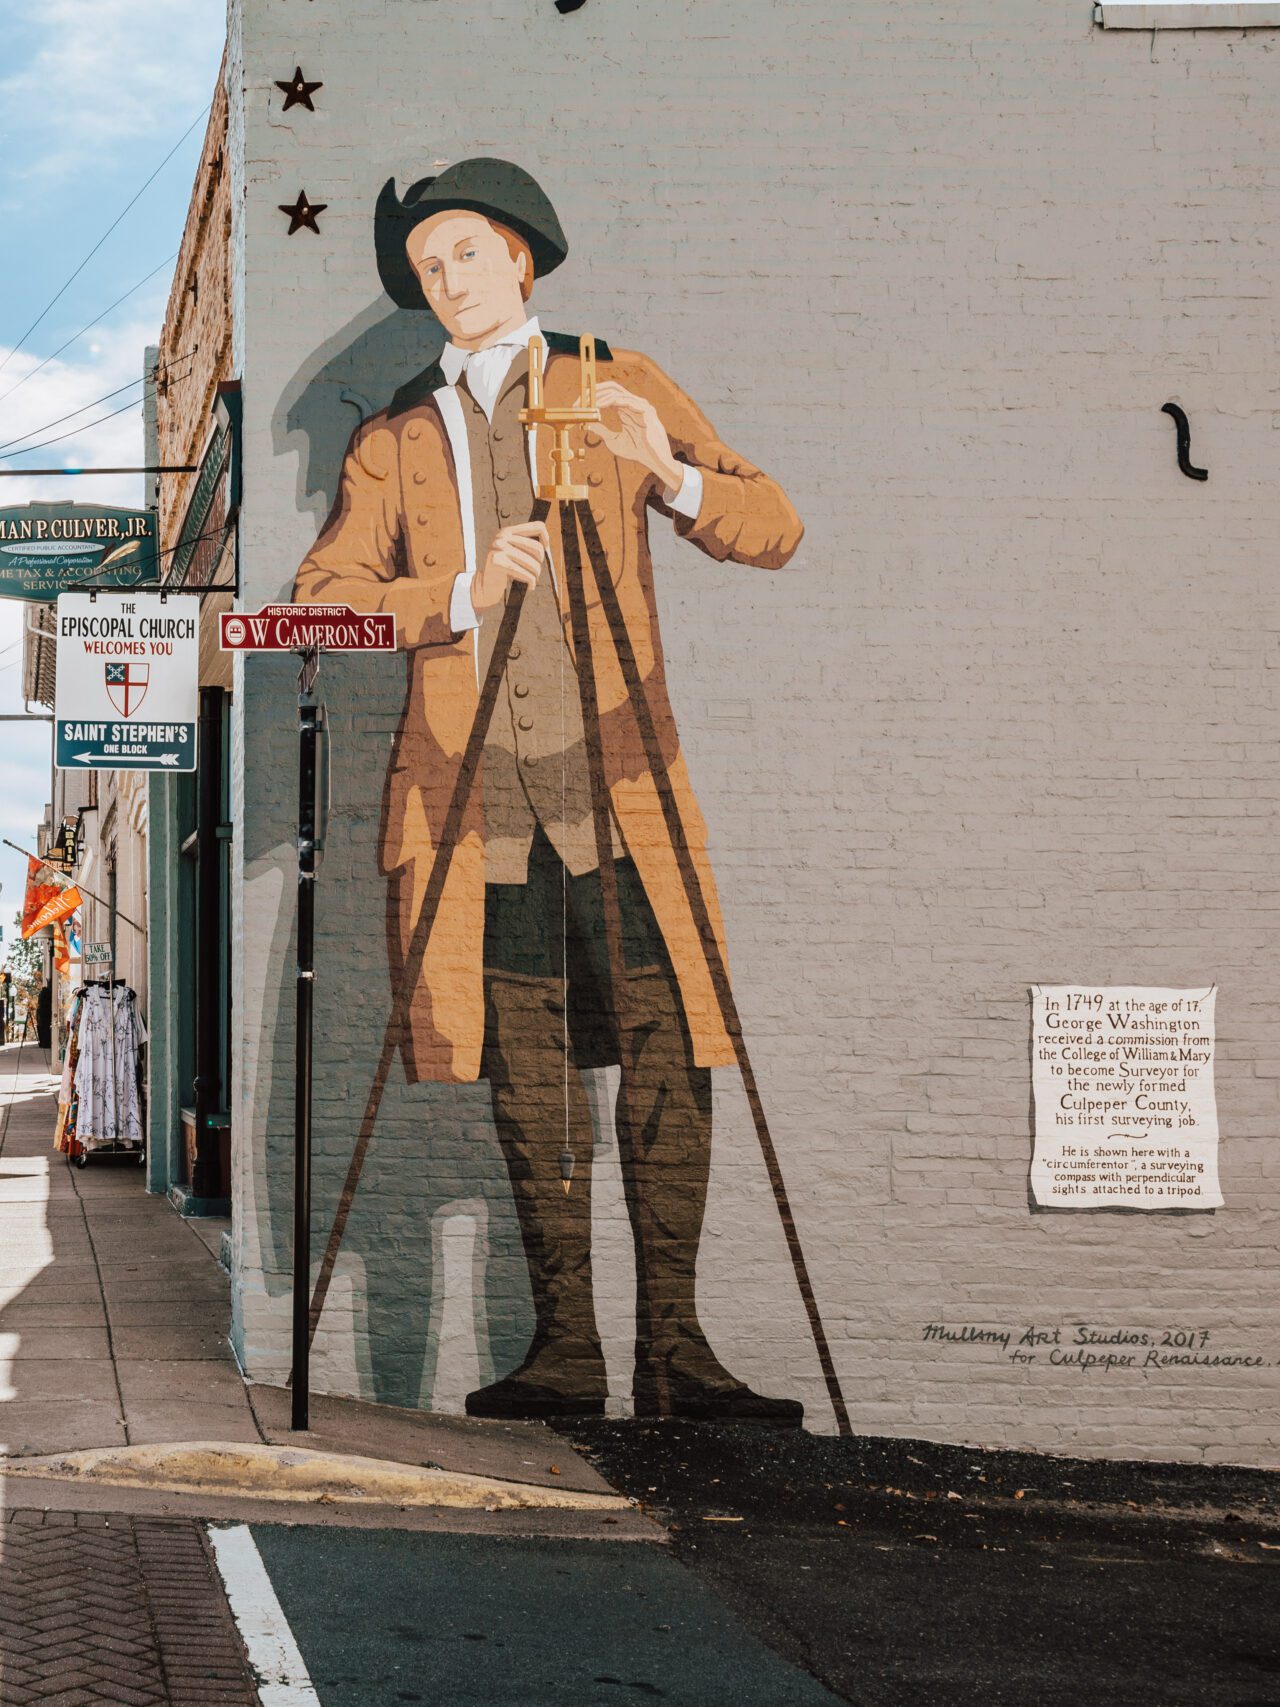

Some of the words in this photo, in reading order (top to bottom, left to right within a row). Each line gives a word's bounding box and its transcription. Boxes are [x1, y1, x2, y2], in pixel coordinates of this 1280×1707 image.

[36, 519, 49, 539] P.
[8, 556, 18, 566] A
[18, 556, 56, 568] Professional
[56, 555, 93, 567] Corporation
[16, 568, 41, 578] TAX
[44, 568, 55, 578] &
[58, 566, 142, 578] ACCOUNTING
[121, 603, 136, 614] THE
[267, 607, 306, 616] HISTORIC
[309, 608, 347, 617] DISTRICT
[61, 617, 134, 638] EPISCOPAL
[139, 618, 195, 639] CHURCH
[248, 618, 270, 646] W
[83, 641, 146, 655] WELCOMES
[150, 642, 173, 655] YOU
[64, 723, 107, 741] SAINT
[111, 725, 188, 743] STEPHEN'S
[103, 744, 119, 753] ONE
[121, 744, 148, 754] BLOCK
[65, 831, 75, 862] BAIL
[89, 945, 105, 953] TAKE
[100, 952, 111, 961] OFF
[1045, 996, 1060, 1011] In
[1066, 993, 1103, 1012] 1749
[1108, 1000, 1120, 1011] at
[1125, 997, 1146, 1011] the
[1148, 1002, 1168, 1014] age
[1171, 998, 1183, 1011] of
[1046, 1012, 1103, 1032] George
[1106, 1013, 1200, 1033] Washington
[1038, 1033, 1092, 1045] received
[1096, 1035, 1104, 1045] a
[1108, 1033, 1179, 1046] commission
[1183, 1033, 1210, 1046] from
[1039, 1047, 1057, 1060] the
[1061, 1047, 1107, 1062] College
[1109, 1047, 1120, 1060] of
[1122, 1047, 1168, 1061] William
[1170, 1051, 1178, 1061] &
[1179, 1048, 1211, 1065] Mary
[1050, 1065, 1063, 1075] to
[1067, 1063, 1115, 1076] become
[1119, 1061, 1179, 1080] Surveyor
[1183, 1064, 1200, 1077] for
[1067, 1078, 1090, 1091] the
[1096, 1078, 1135, 1095] newly
[1139, 1078, 1186, 1092] formed
[1060, 1093, 1128, 1113] Culpeper
[1135, 1094, 1191, 1114] County,
[1055, 1112, 1073, 1125] his
[1078, 1112, 1105, 1125] first
[1111, 1114, 1173, 1128] surveying
[1178, 1114, 1200, 1128] job.
[1062, 1145, 1077, 1156] He
[1080, 1146, 1089, 1156] is
[1093, 1146, 1128, 1156] shown
[1131, 1147, 1155, 1156] here
[1156, 1147, 1180, 1157] with
[1184, 1150, 1190, 1158] a
[1150, 1160, 1204, 1173] surveying
[1054, 1173, 1096, 1183] compass
[1099, 1172, 1122, 1182] with
[1125, 1172, 1196, 1184] perpendicular
[1052, 1184, 1086, 1196] sights
[1092, 1184, 1140, 1194] attached
[1144, 1185, 1154, 1195] to
[1157, 1187, 1163, 1195] a
[1160, 1330, 1211, 1349] 2017
[1009, 1349, 1036, 1365] for
[1049, 1349, 1135, 1372] Culpeper
